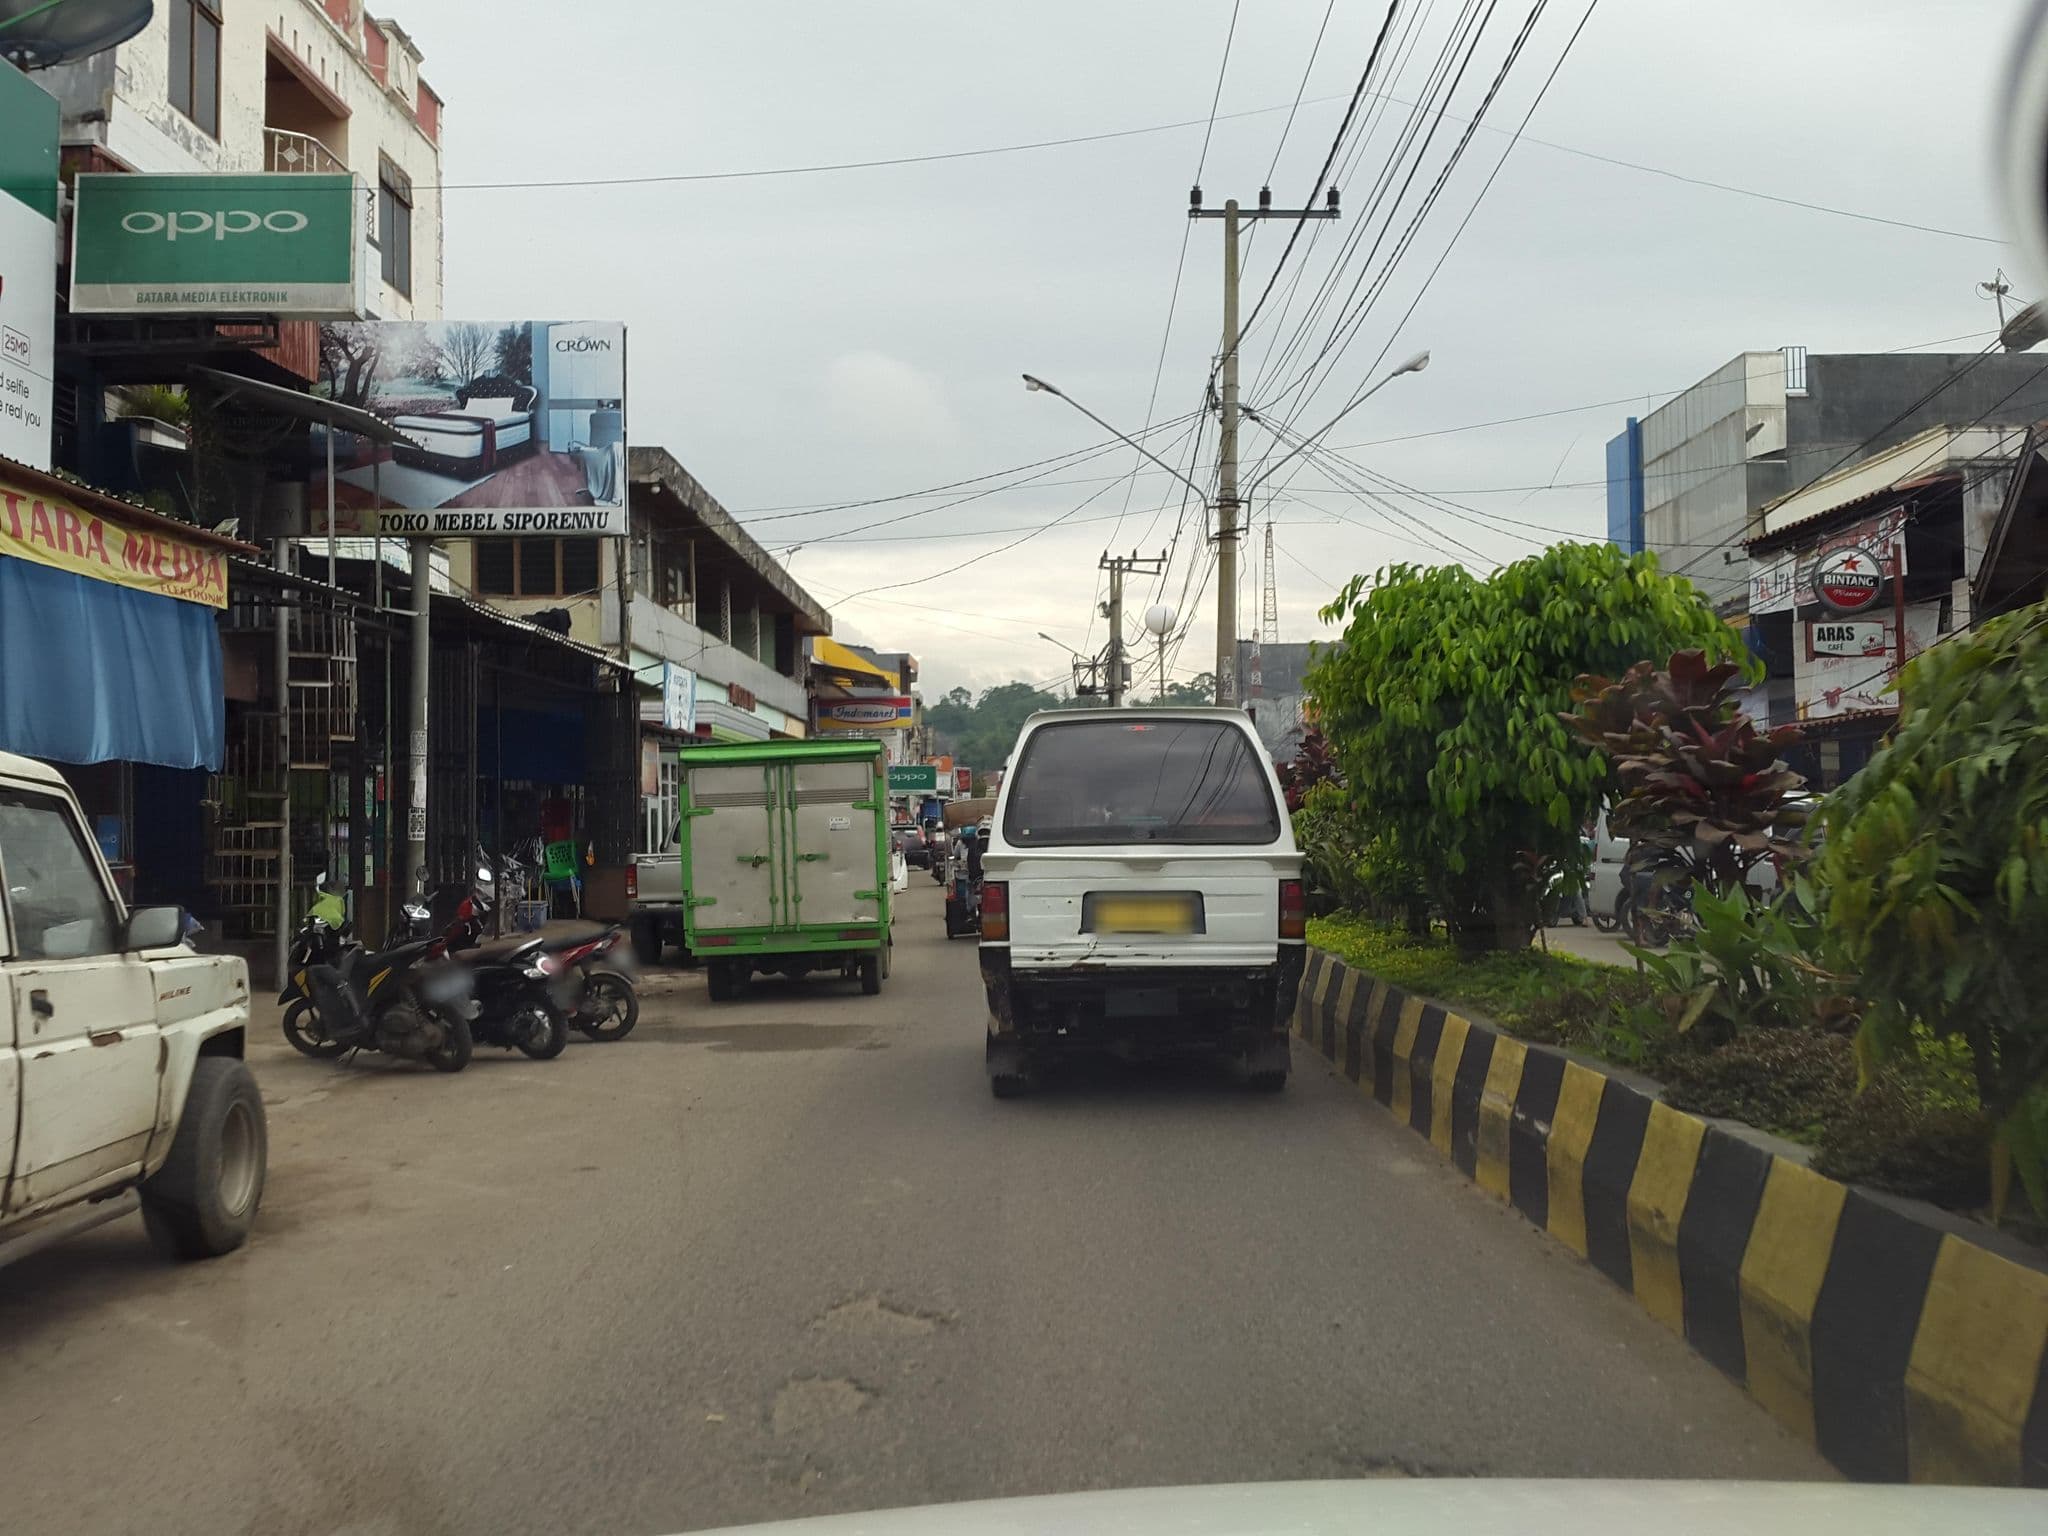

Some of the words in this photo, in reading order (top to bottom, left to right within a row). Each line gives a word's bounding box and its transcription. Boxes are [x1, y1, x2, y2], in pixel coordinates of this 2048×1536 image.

[121, 210, 309, 241] oppo
[136, 291, 178, 304] BATARA
[181, 291, 217, 303] MEDIA
[219, 290, 288, 303] ELEKTRONIK
[4, 333, 28, 356] 25MP
[555, 337, 611, 353] CROWN
[5, 377, 30, 399] selfie
[5, 401, 23, 420] real
[24, 407, 41, 427] you
[379, 513, 429, 532] TOKO
[433, 512, 498, 532] MEBEL
[502, 511, 610, 530] SIPORENNU
[0, 489, 110, 565] TARA
[121, 532, 224, 593] MEDIA
[1823, 574, 1875, 587] BINTANG
[160, 584, 225, 605] ELEKTRONIK
[1816, 626, 1855, 642] ARAS
[835, 708, 895, 719] Indomaret
[888, 773, 927, 782] oppo
